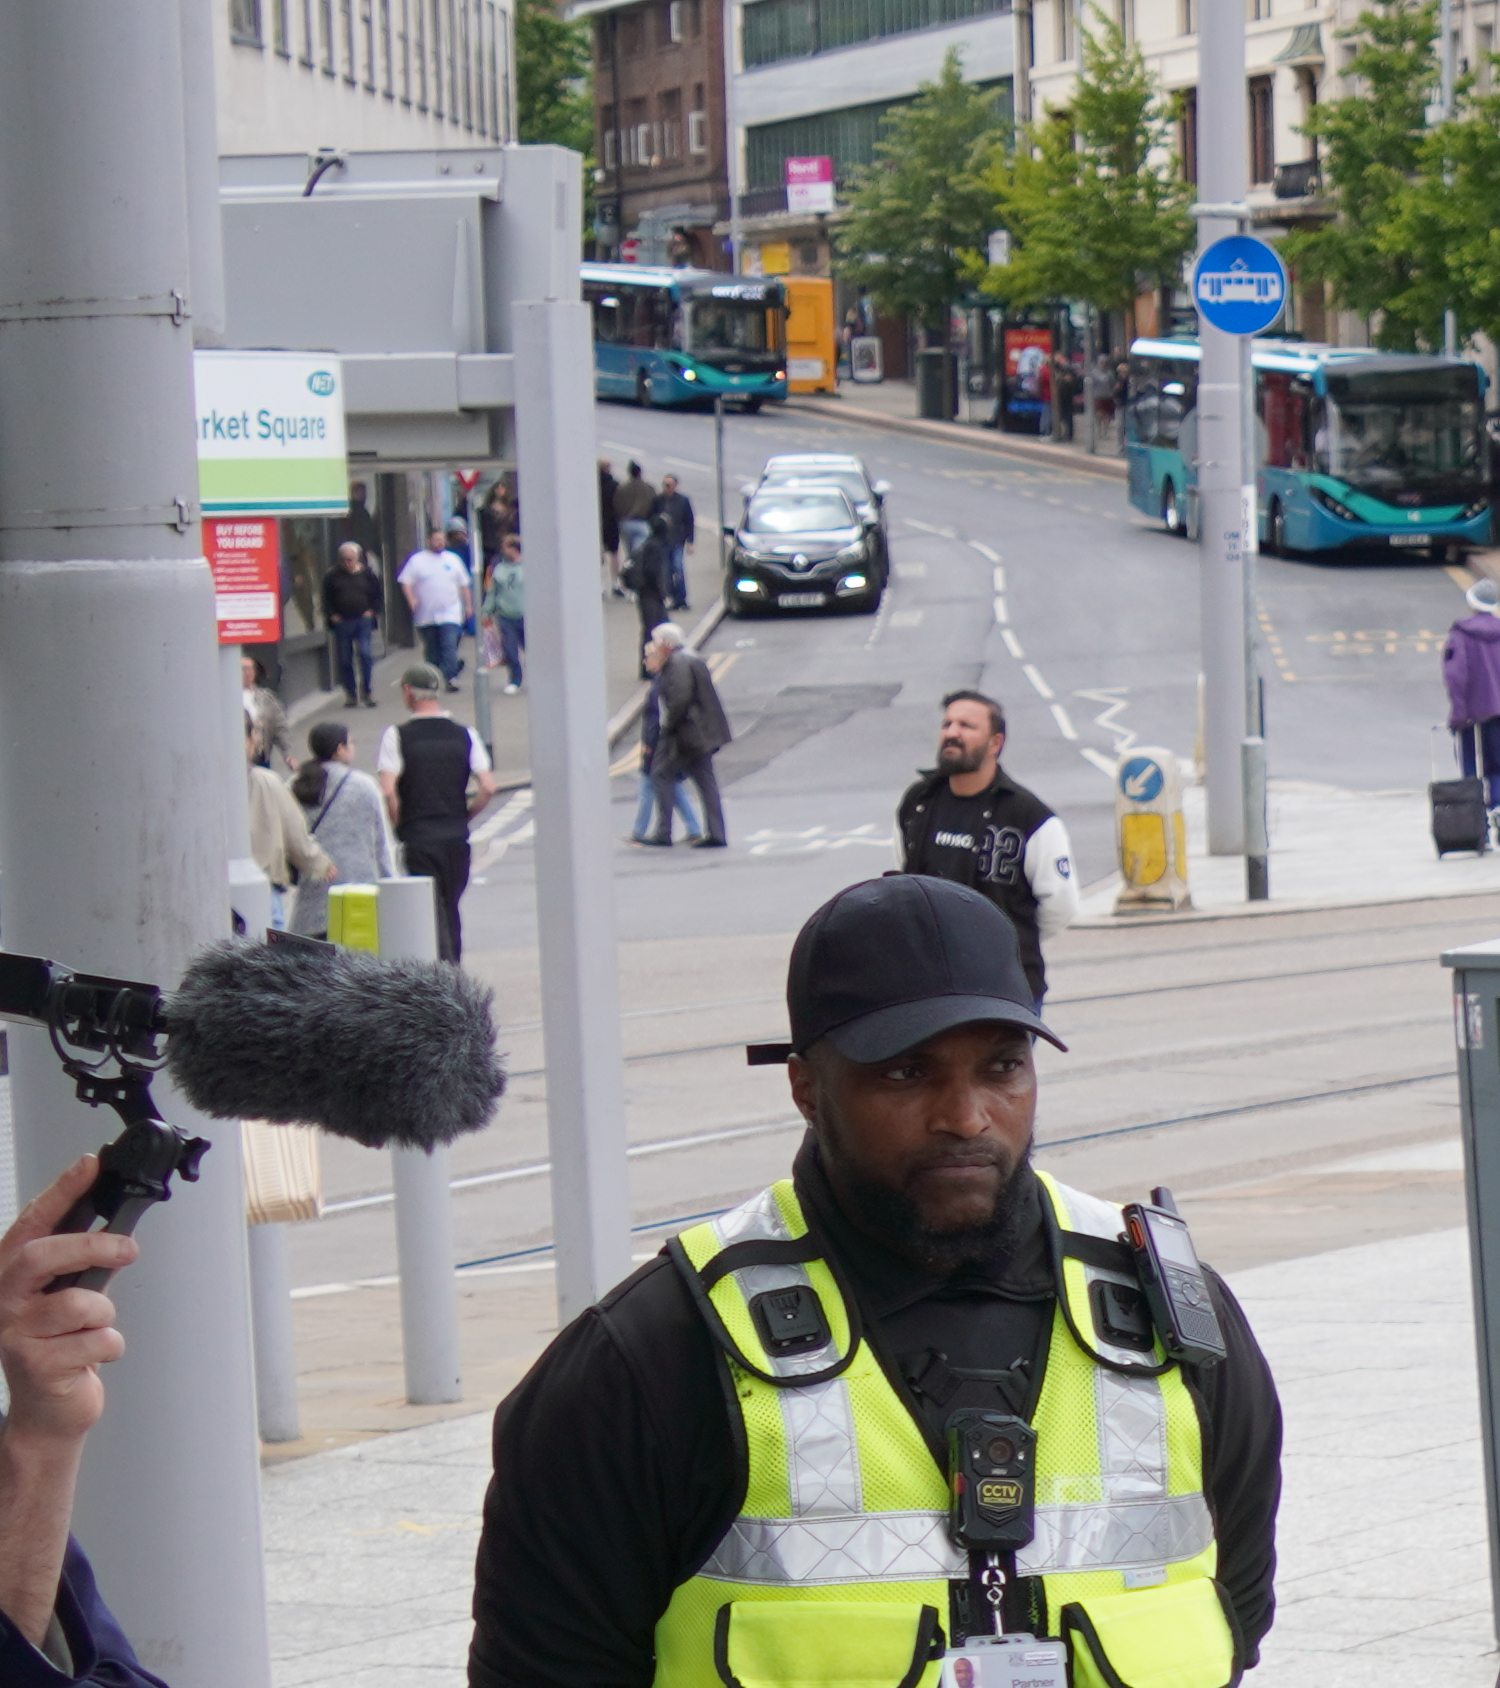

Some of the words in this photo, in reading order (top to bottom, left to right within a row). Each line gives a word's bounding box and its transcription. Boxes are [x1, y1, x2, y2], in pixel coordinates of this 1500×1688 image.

[257, 410, 326, 446] Square
[981, 1484, 1018, 1497] CCTV
[1011, 1679, 1056, 1688] Partner
